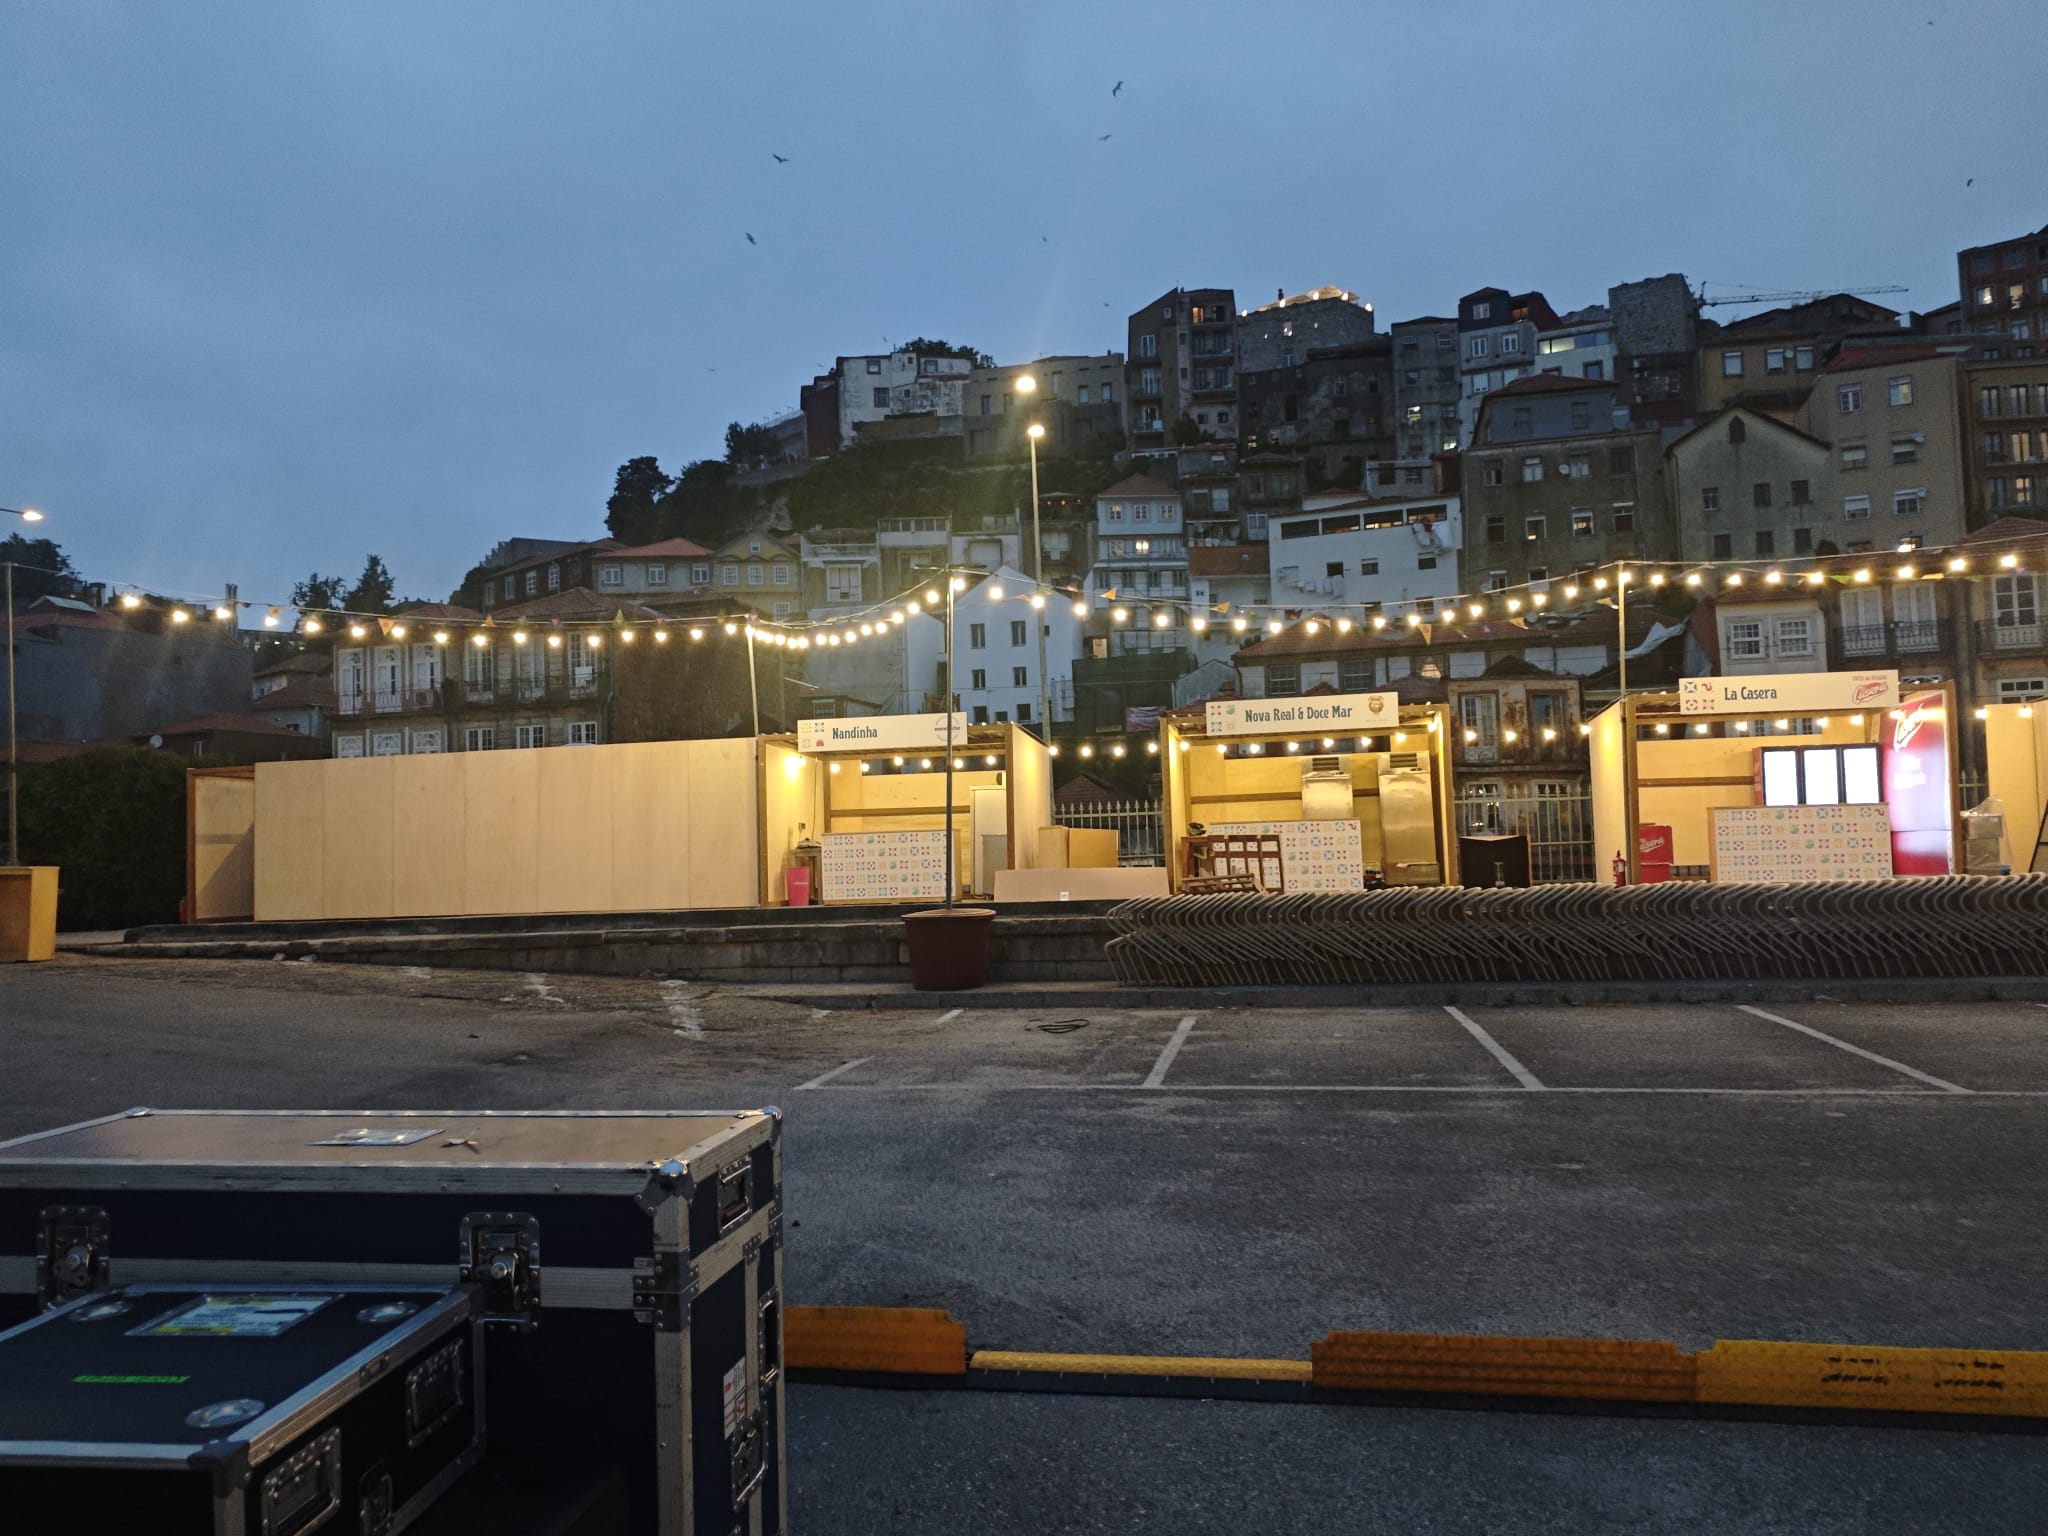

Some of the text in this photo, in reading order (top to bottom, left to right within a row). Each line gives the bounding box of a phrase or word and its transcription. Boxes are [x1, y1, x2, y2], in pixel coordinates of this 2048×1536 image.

[1724, 686, 1777, 701] La Casera
[1245, 705, 1353, 722] Nova Real & Doce Mar
[832, 726, 878, 740] Nandinha
